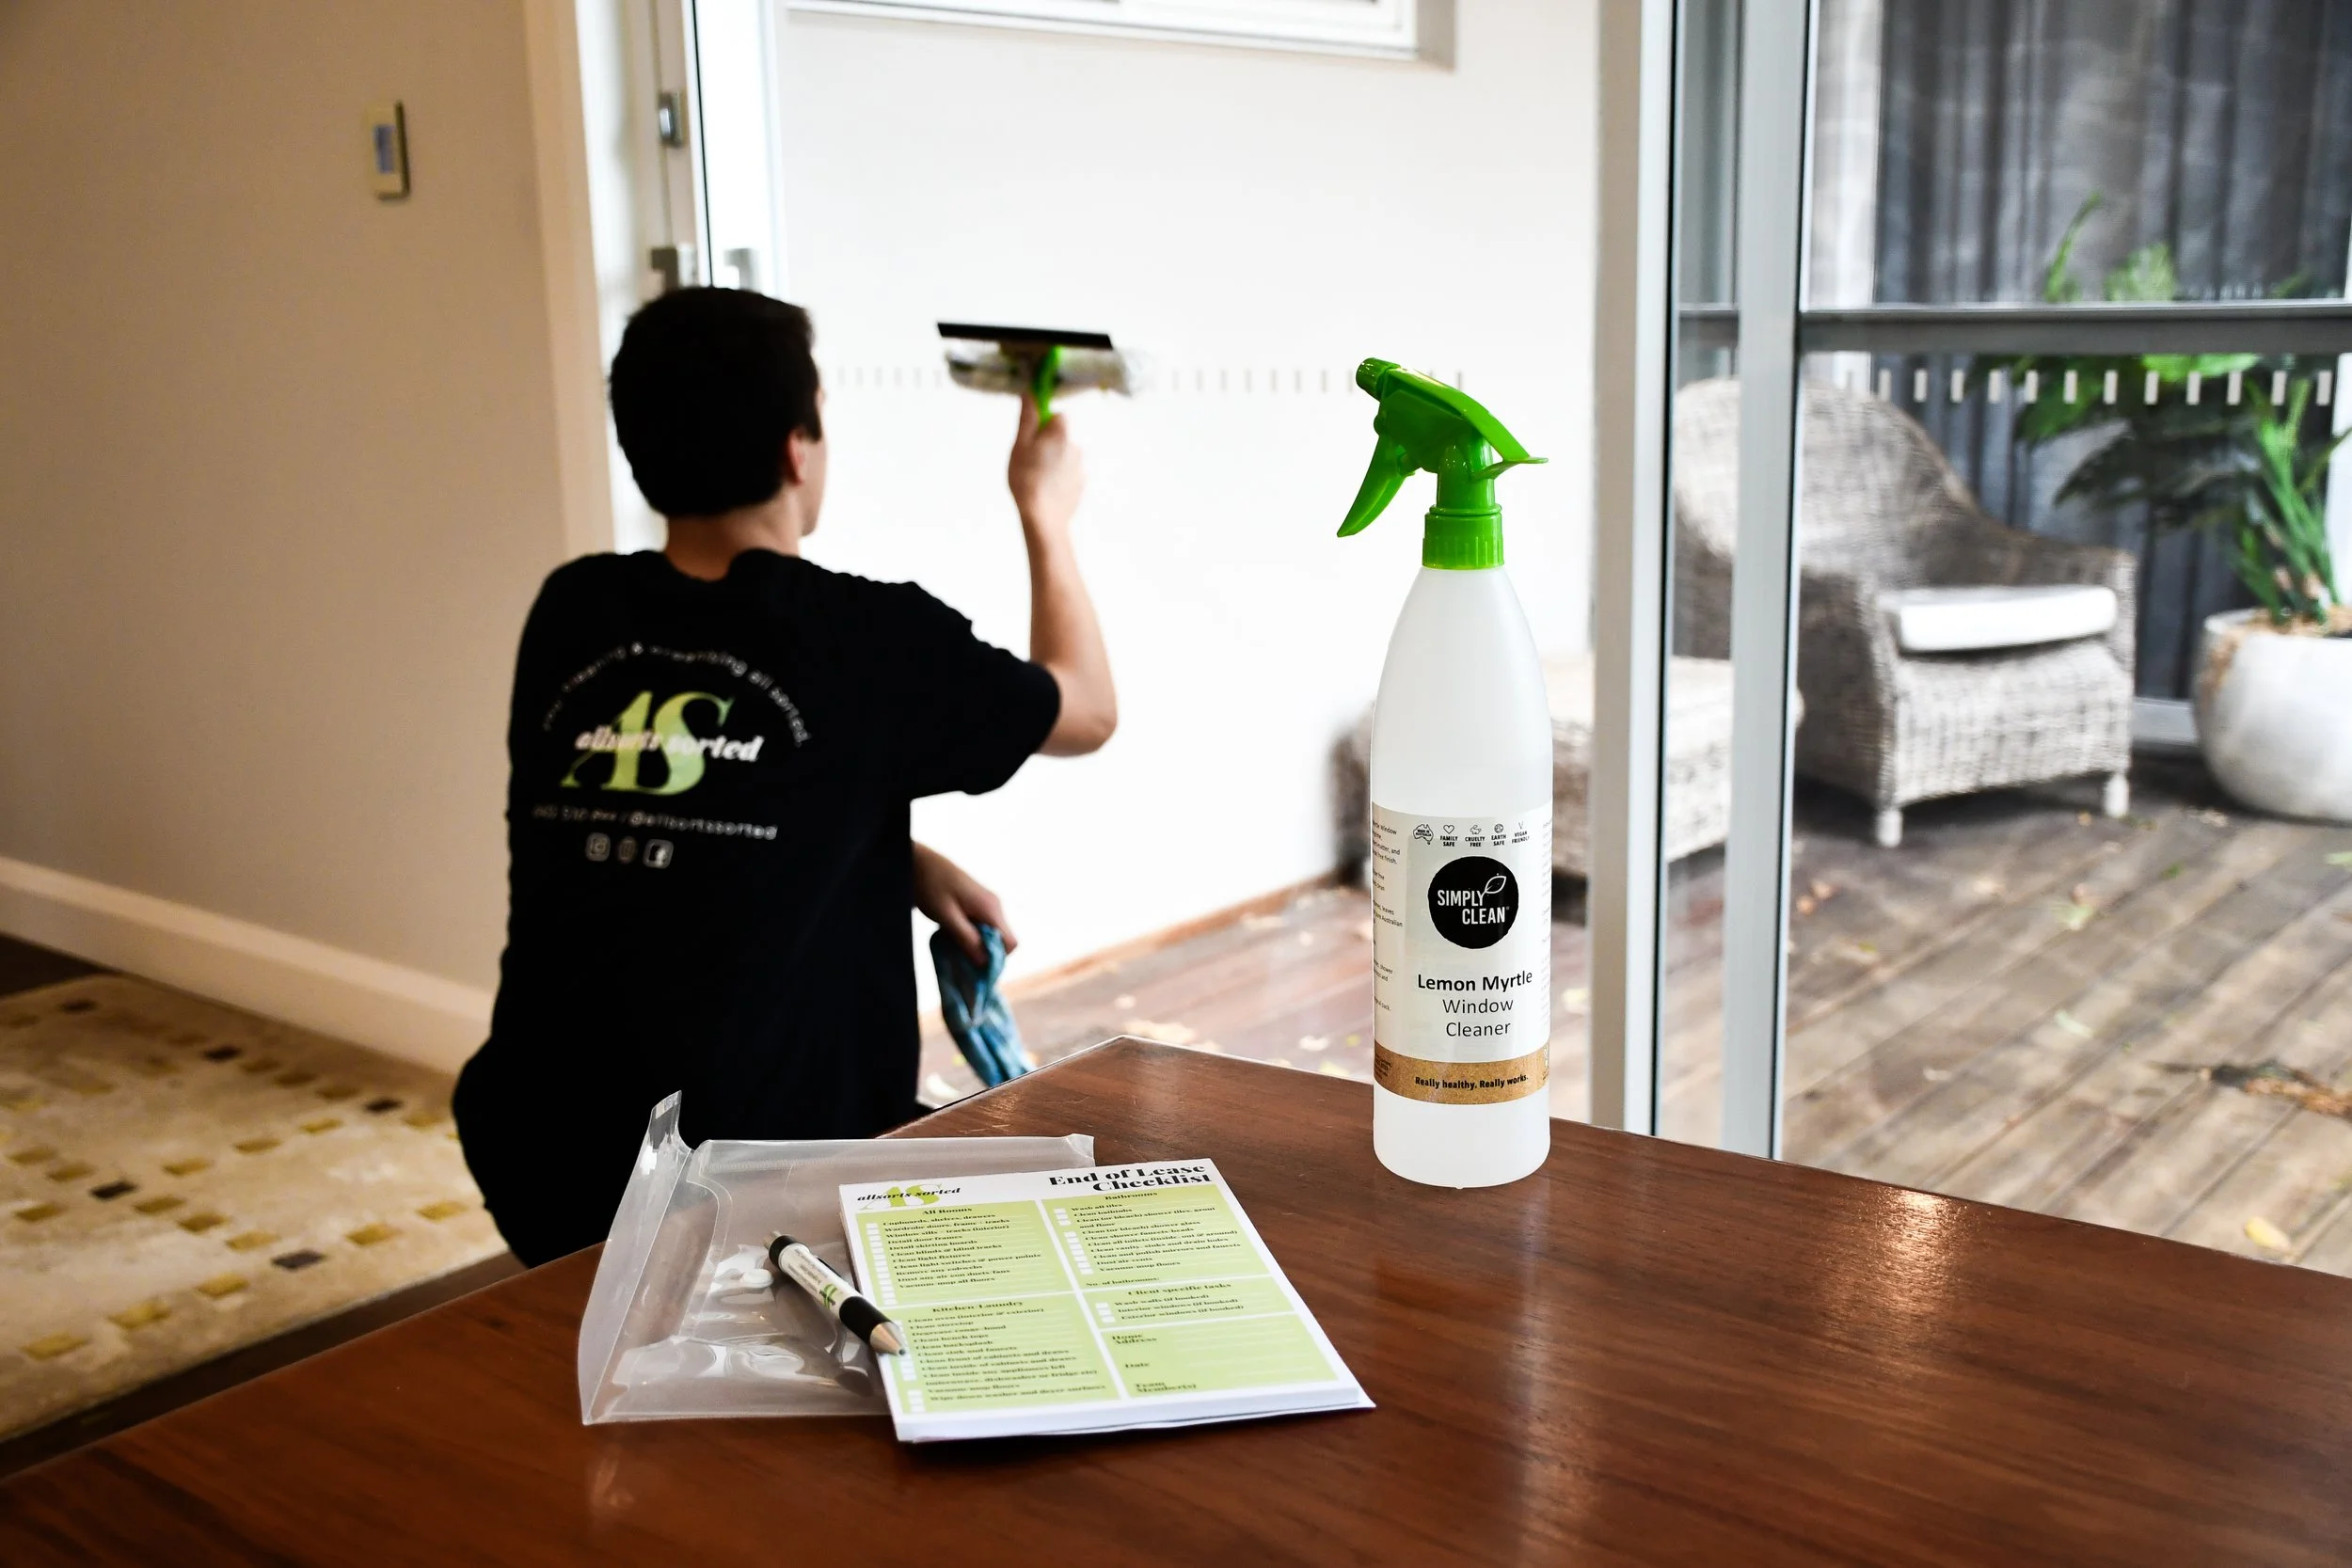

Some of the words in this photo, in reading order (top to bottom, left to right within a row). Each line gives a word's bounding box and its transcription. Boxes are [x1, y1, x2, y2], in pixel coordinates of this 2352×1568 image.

[560, 689, 735, 796] AS
[664, 734, 765, 763] sorted
[1511, 835, 1530, 844] FRIENDLY
[1437, 889, 1486, 907] SIMPLY
[1462, 906, 1505, 925] CLEAN
[1418, 974, 1476, 991] Lemon
[1482, 970, 1533, 992] Myrtle
[1442, 998, 1514, 1014] Window
[1446, 1022, 1511, 1037] Cleaner
[1415, 1076, 1440, 1089] Really
[1442, 1077, 1478, 1091] healthy.
[1480, 1077, 1505, 1089] Really
[1506, 1074, 1529, 1085] works.
[1049, 1172, 1099, 1185] End
[1105, 1169, 1131, 1180] of
[1136, 1165, 1206, 1177] Lease
[1092, 1174, 1213, 1191] Checklist
[857, 1192, 912, 1201] allsorts
[914, 1187, 961, 1196] sorted
[1104, 1192, 1157, 1200] Bathrooms
